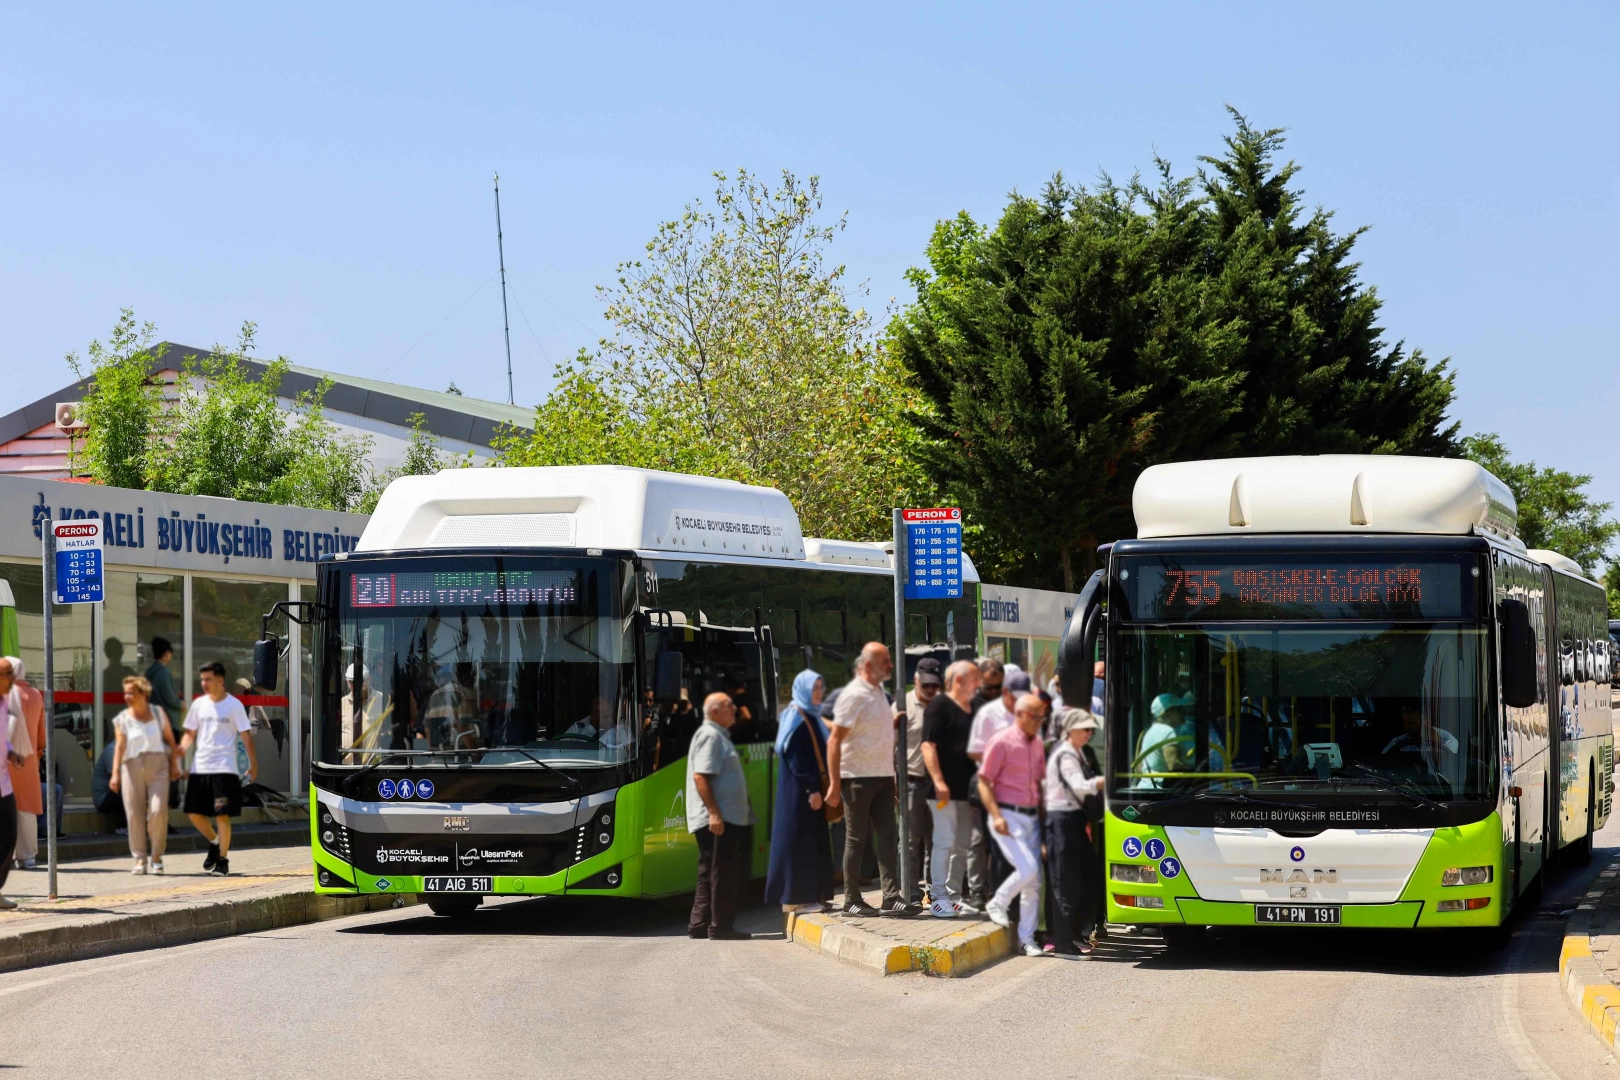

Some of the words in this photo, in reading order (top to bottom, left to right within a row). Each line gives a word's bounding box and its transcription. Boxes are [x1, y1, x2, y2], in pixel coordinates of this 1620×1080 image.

[60, 527, 88, 535] PERON
[158, 510, 272, 564] BÜYÜKŞEHİR
[646, 571, 658, 593] 511
[1166, 570, 1220, 606] 755
[358, 578, 388, 604] 20
[1240, 586, 1324, 603] GAZANFER
[1386, 586, 1422, 602] MYO
[1330, 810, 1380, 820] BELEDİYESİ
[444, 816, 469, 830] BMC
[1260, 868, 1337, 883] MAN
[428, 878, 439, 890] 41
[445, 878, 466, 890] AIG
[472, 878, 487, 890] 511
[1266, 908, 1280, 921] 41
[1291, 908, 1306, 922] PN
[1314, 908, 1334, 922] 191
